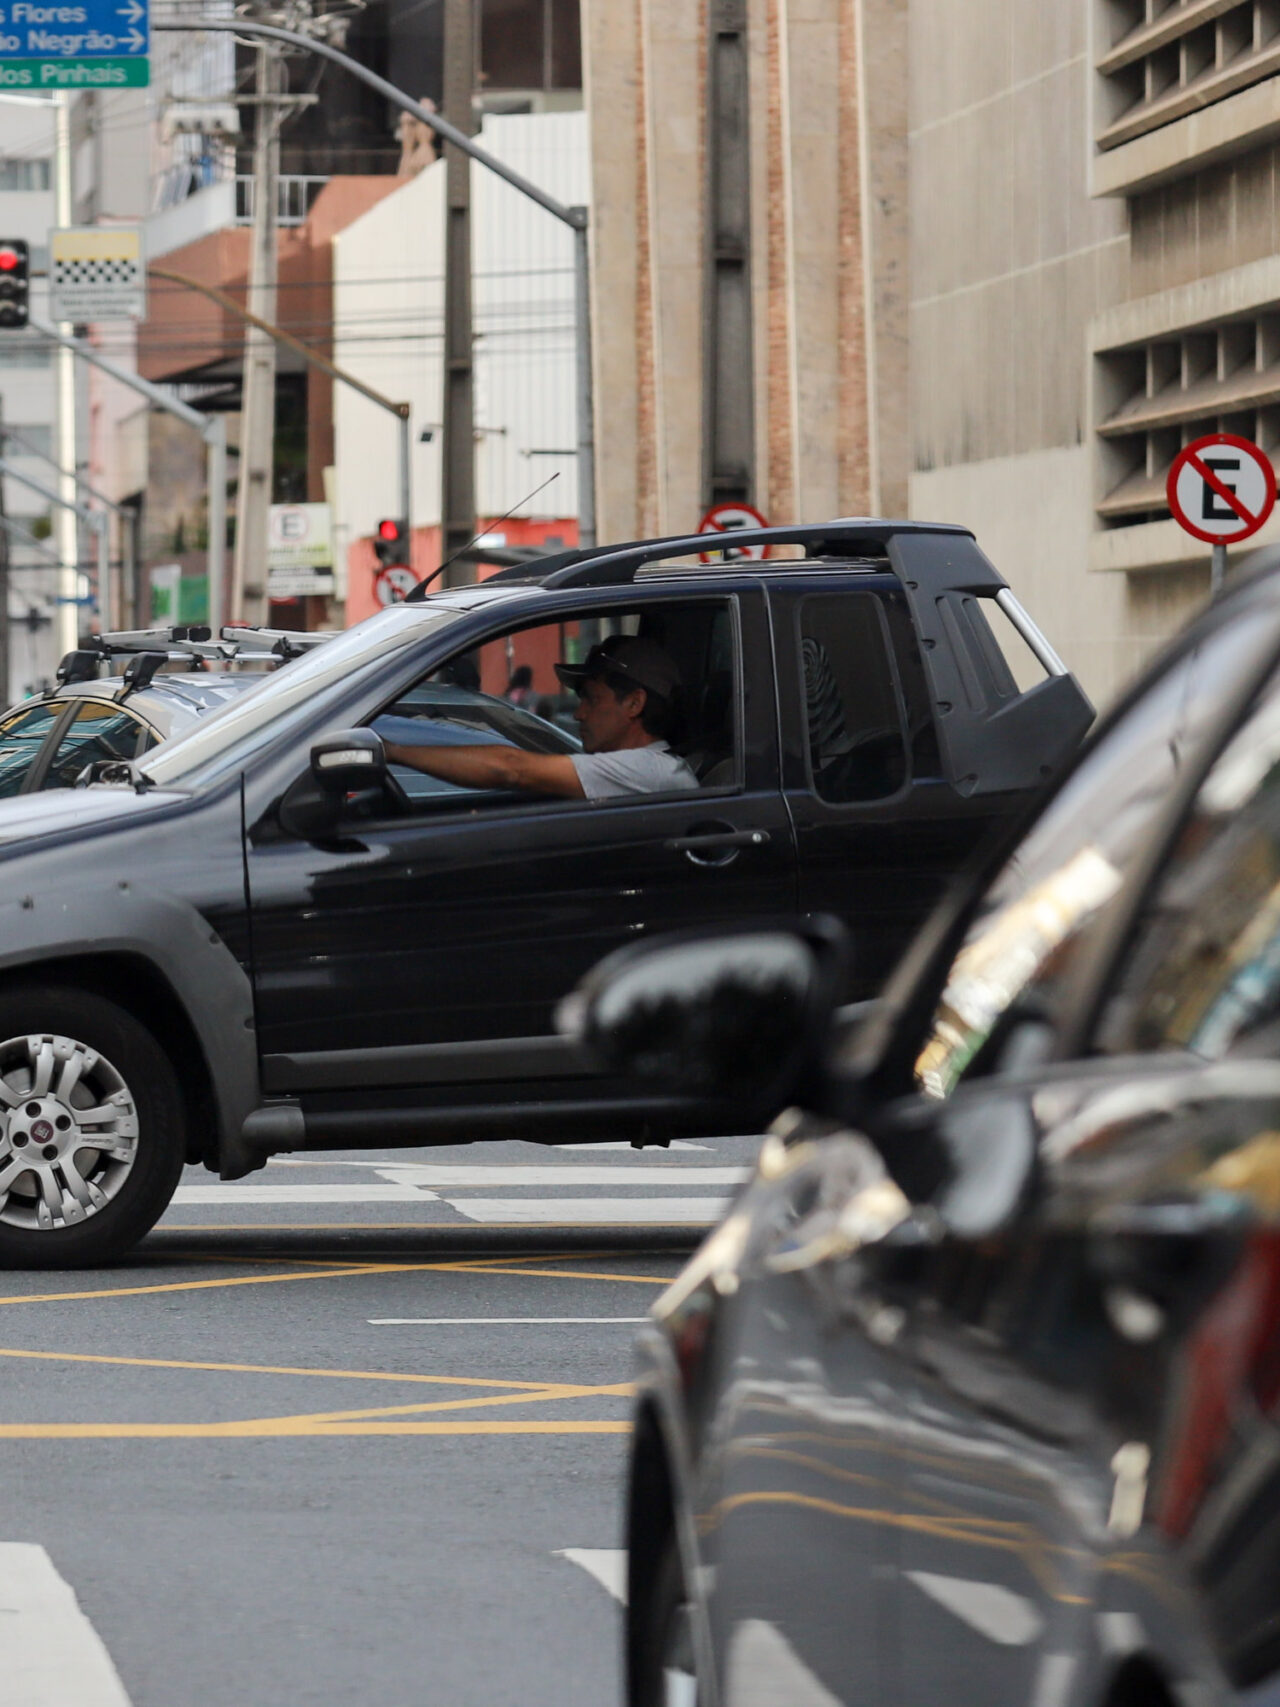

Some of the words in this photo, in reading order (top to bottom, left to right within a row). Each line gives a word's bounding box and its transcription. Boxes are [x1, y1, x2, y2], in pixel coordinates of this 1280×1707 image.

[12, 4, 87, 23] Flores
[28, 30, 116, 55] Negrão
[41, 62, 127, 83] Pinhais
[1202, 458, 1240, 520] E
[281, 513, 301, 538] E
